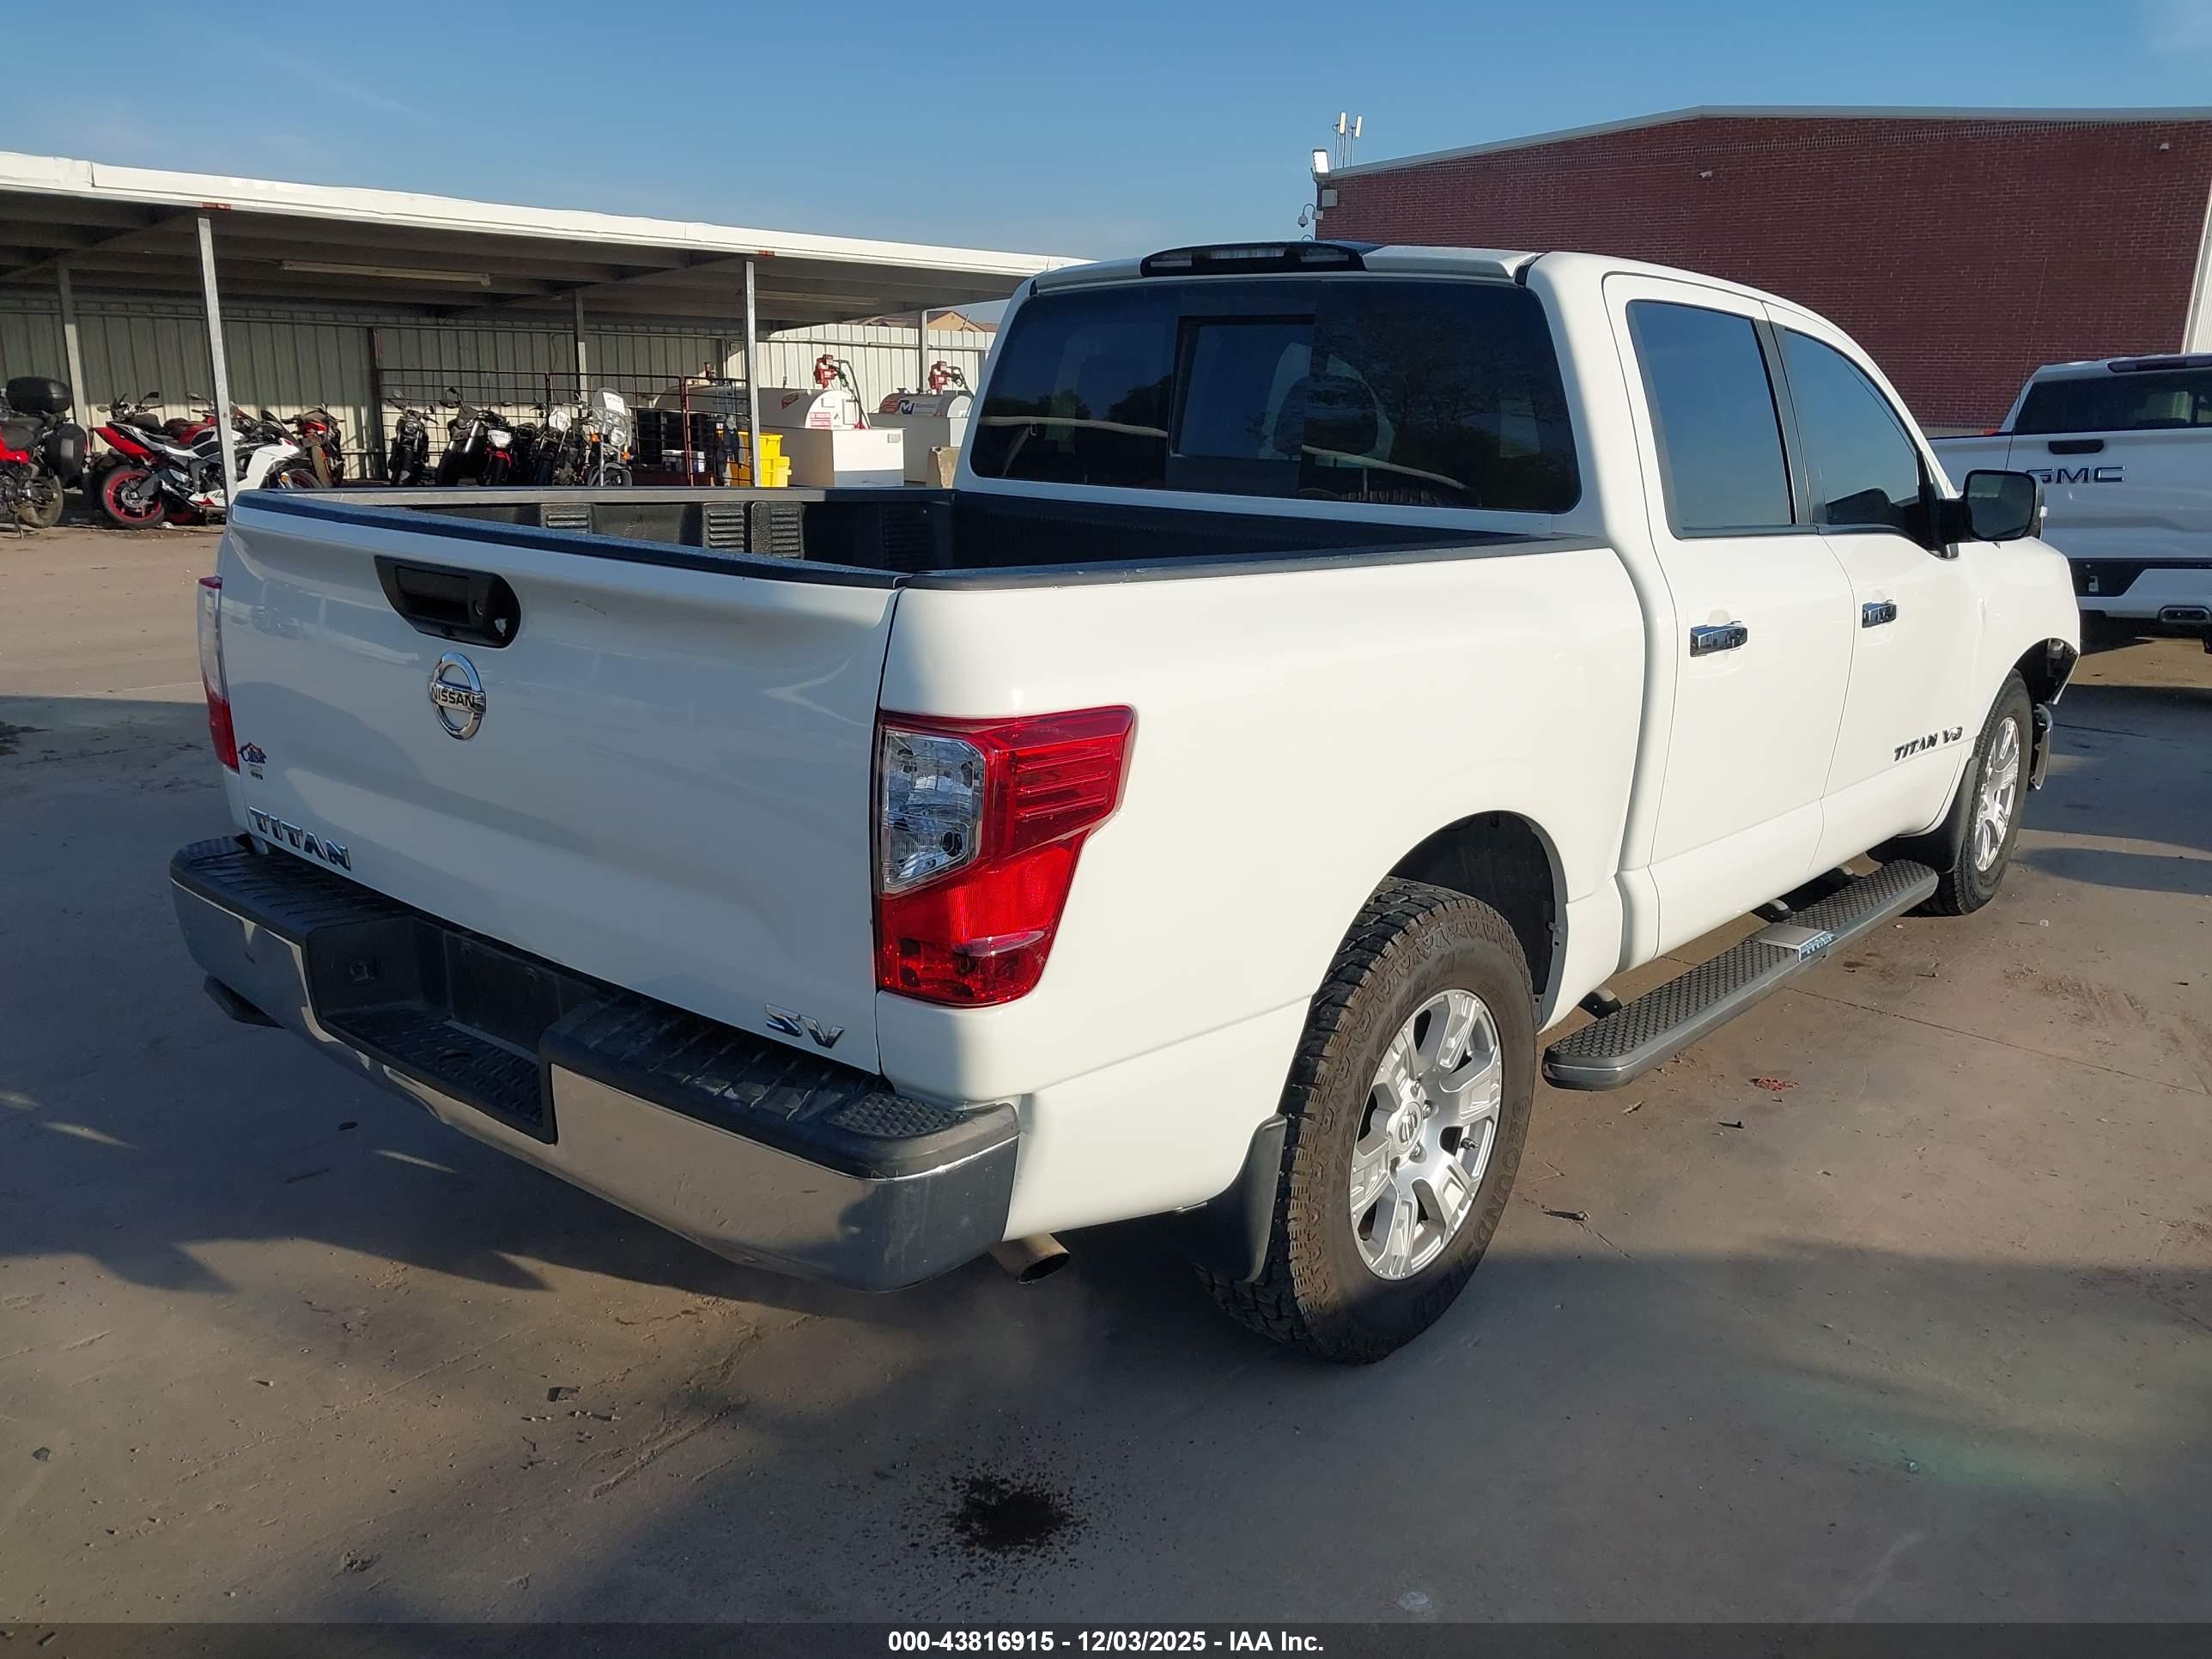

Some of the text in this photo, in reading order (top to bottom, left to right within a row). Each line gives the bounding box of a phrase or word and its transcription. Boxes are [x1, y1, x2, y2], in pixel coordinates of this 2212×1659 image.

[2026, 465, 2126, 484] GMC
[431, 686, 475, 707] NISSAN
[1894, 732, 1938, 762] TITAN
[248, 805, 352, 872] TITAN
[765, 1003, 845, 1049] SV
